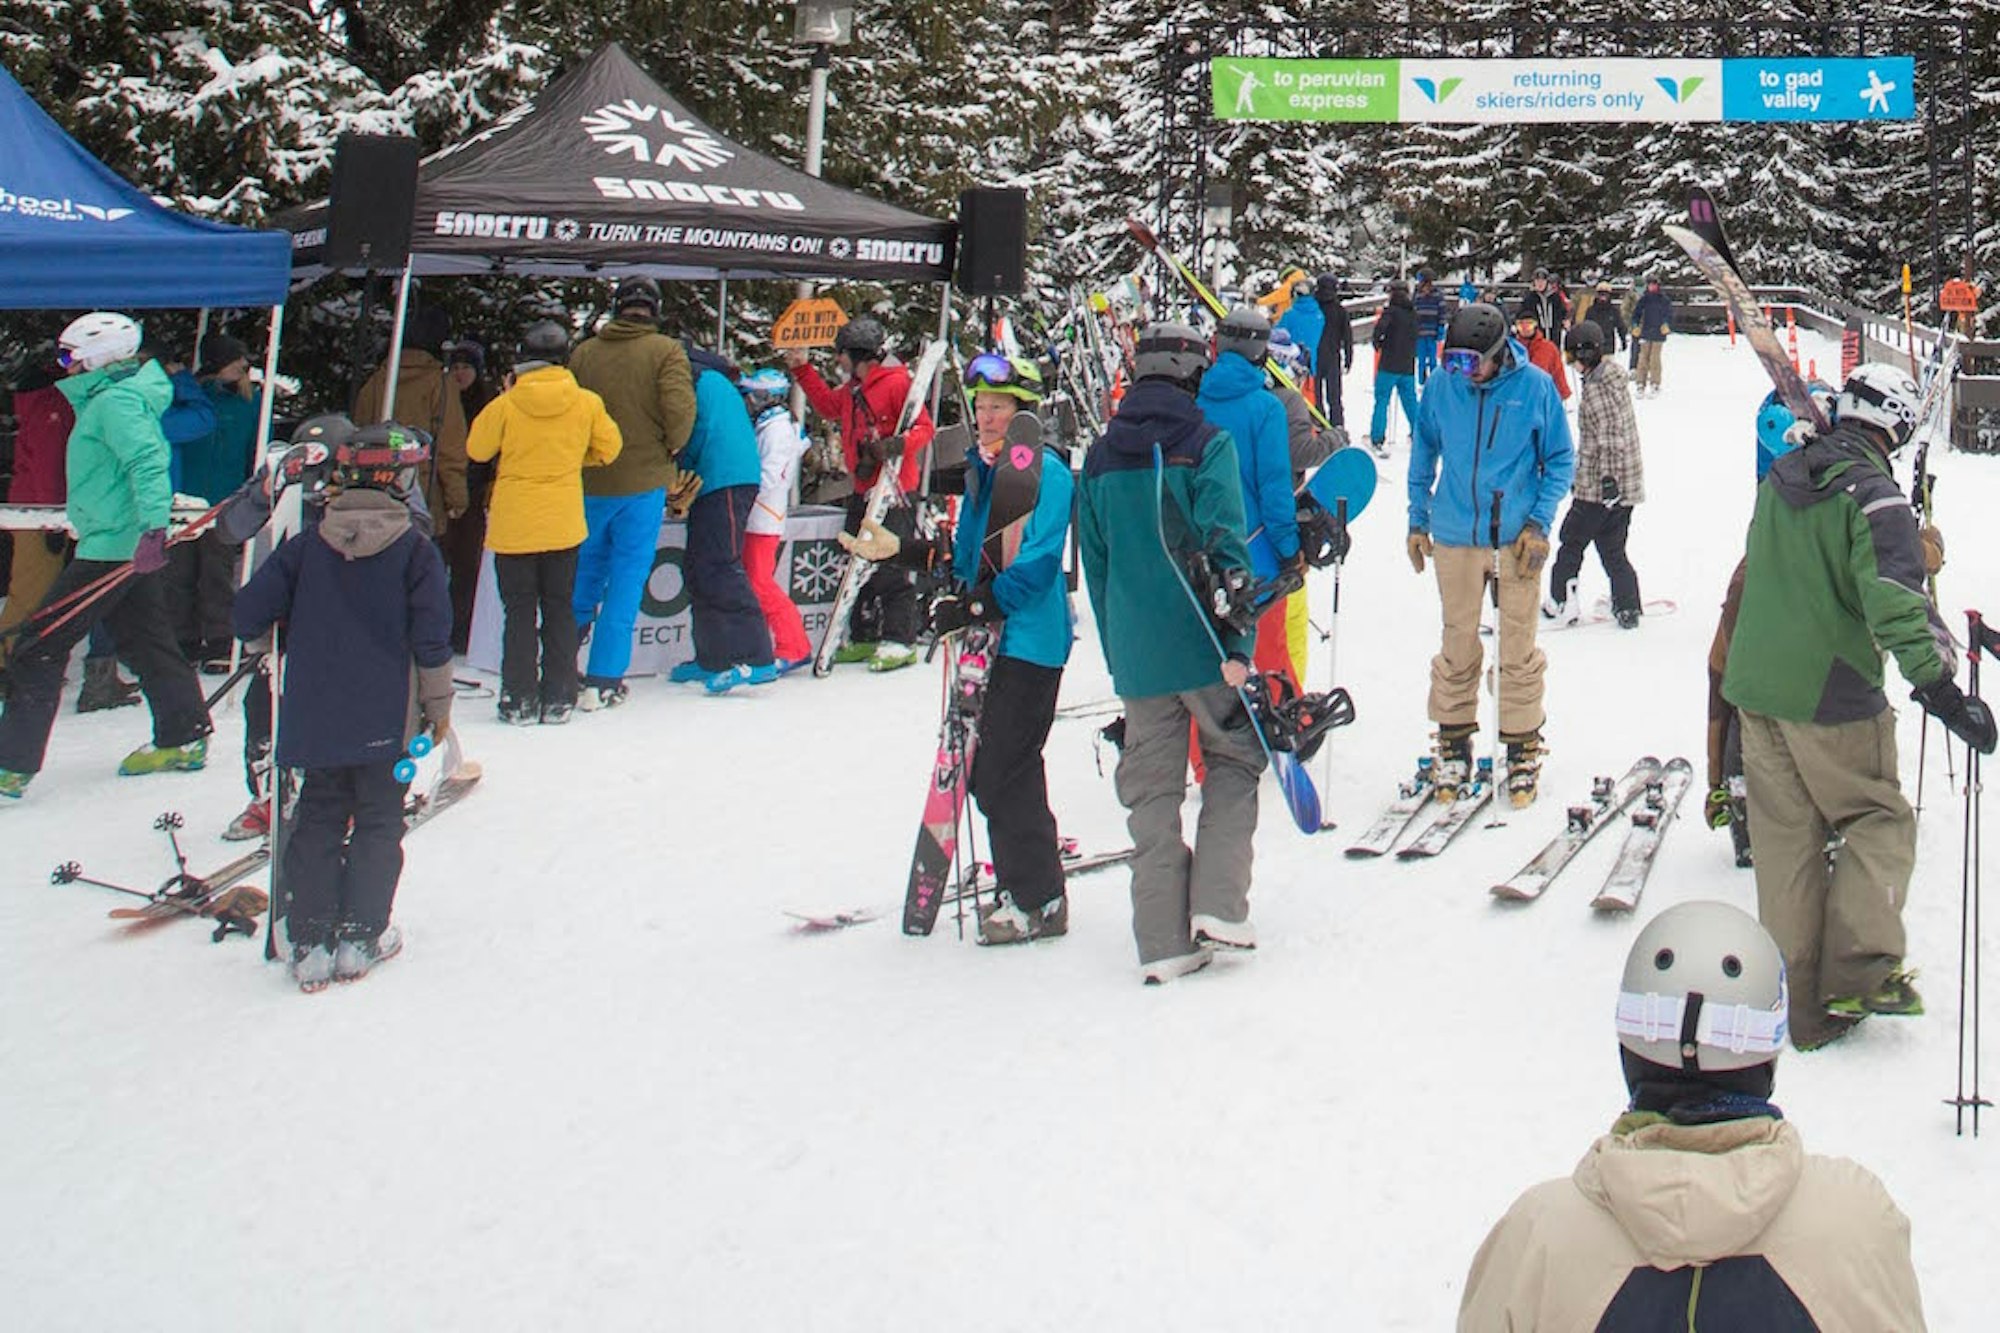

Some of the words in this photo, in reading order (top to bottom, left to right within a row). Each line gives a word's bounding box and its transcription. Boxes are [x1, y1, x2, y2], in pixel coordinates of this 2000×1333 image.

[1274, 71, 1293, 87] to
[1299, 70, 1386, 91] peruvian
[1514, 70, 1602, 90] returning
[1759, 69, 1780, 87] to
[1785, 69, 1823, 91] gad
[1289, 93, 1369, 111] express
[1476, 92, 1597, 108] skiers/riders
[1603, 91, 1644, 111] only
[1762, 91, 1821, 112] valley
[588, 223, 642, 242] TURN
[645, 226, 682, 244] THE
[683, 228, 789, 252] MOUNTAINS
[790, 237, 824, 255] ON!
[794, 312, 810, 325] SKI
[815, 310, 838, 324] WITH
[781, 325, 837, 341] CAUTIO
[1842, 329, 1860, 382] ATOM
